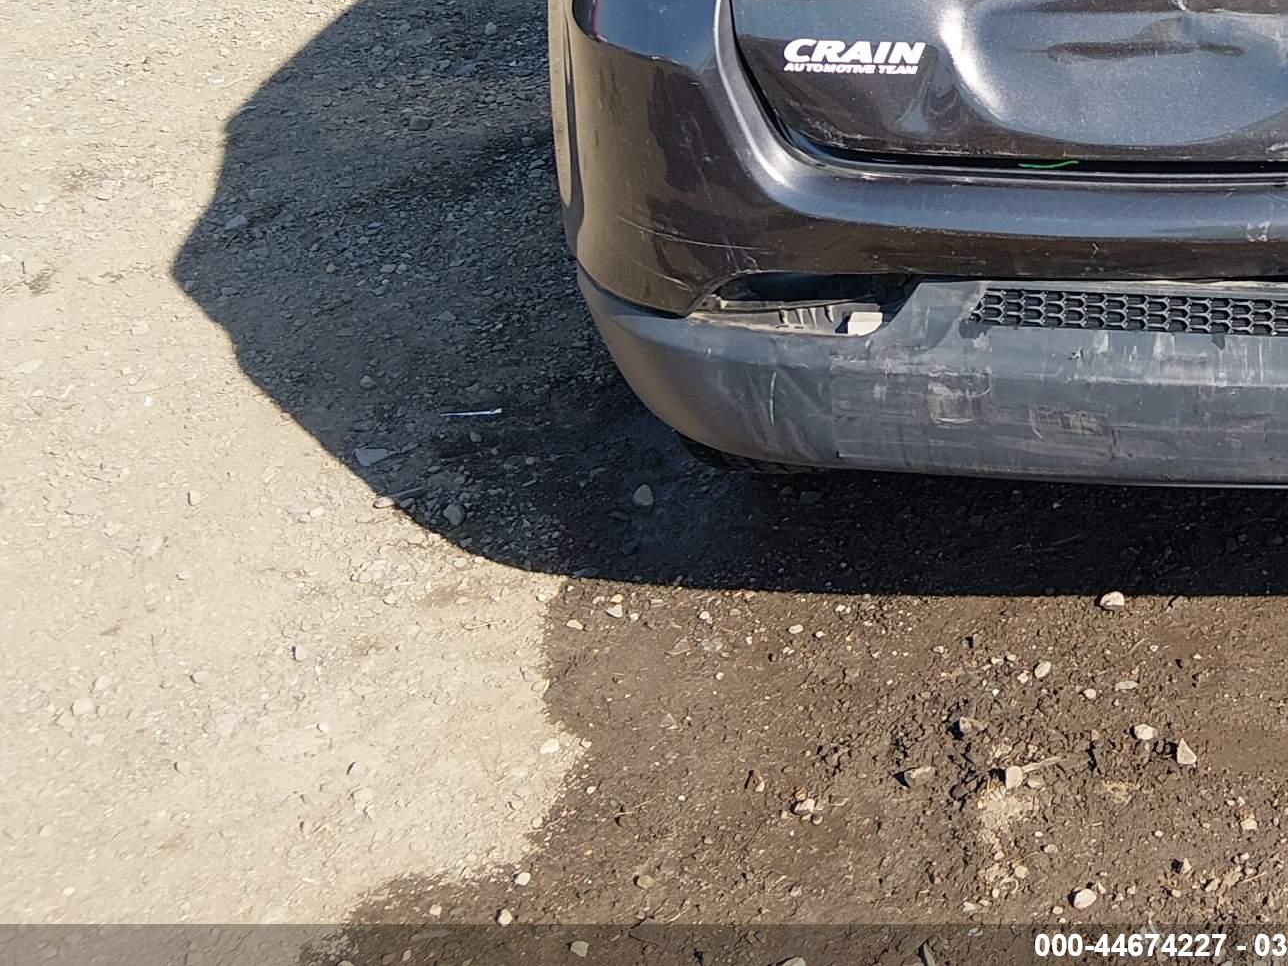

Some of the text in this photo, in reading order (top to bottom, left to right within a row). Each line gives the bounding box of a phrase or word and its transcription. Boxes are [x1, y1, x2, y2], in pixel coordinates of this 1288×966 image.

[783, 38, 926, 65] CRAIN
[784, 62, 919, 75] AUTOMOTIVE TEAM
